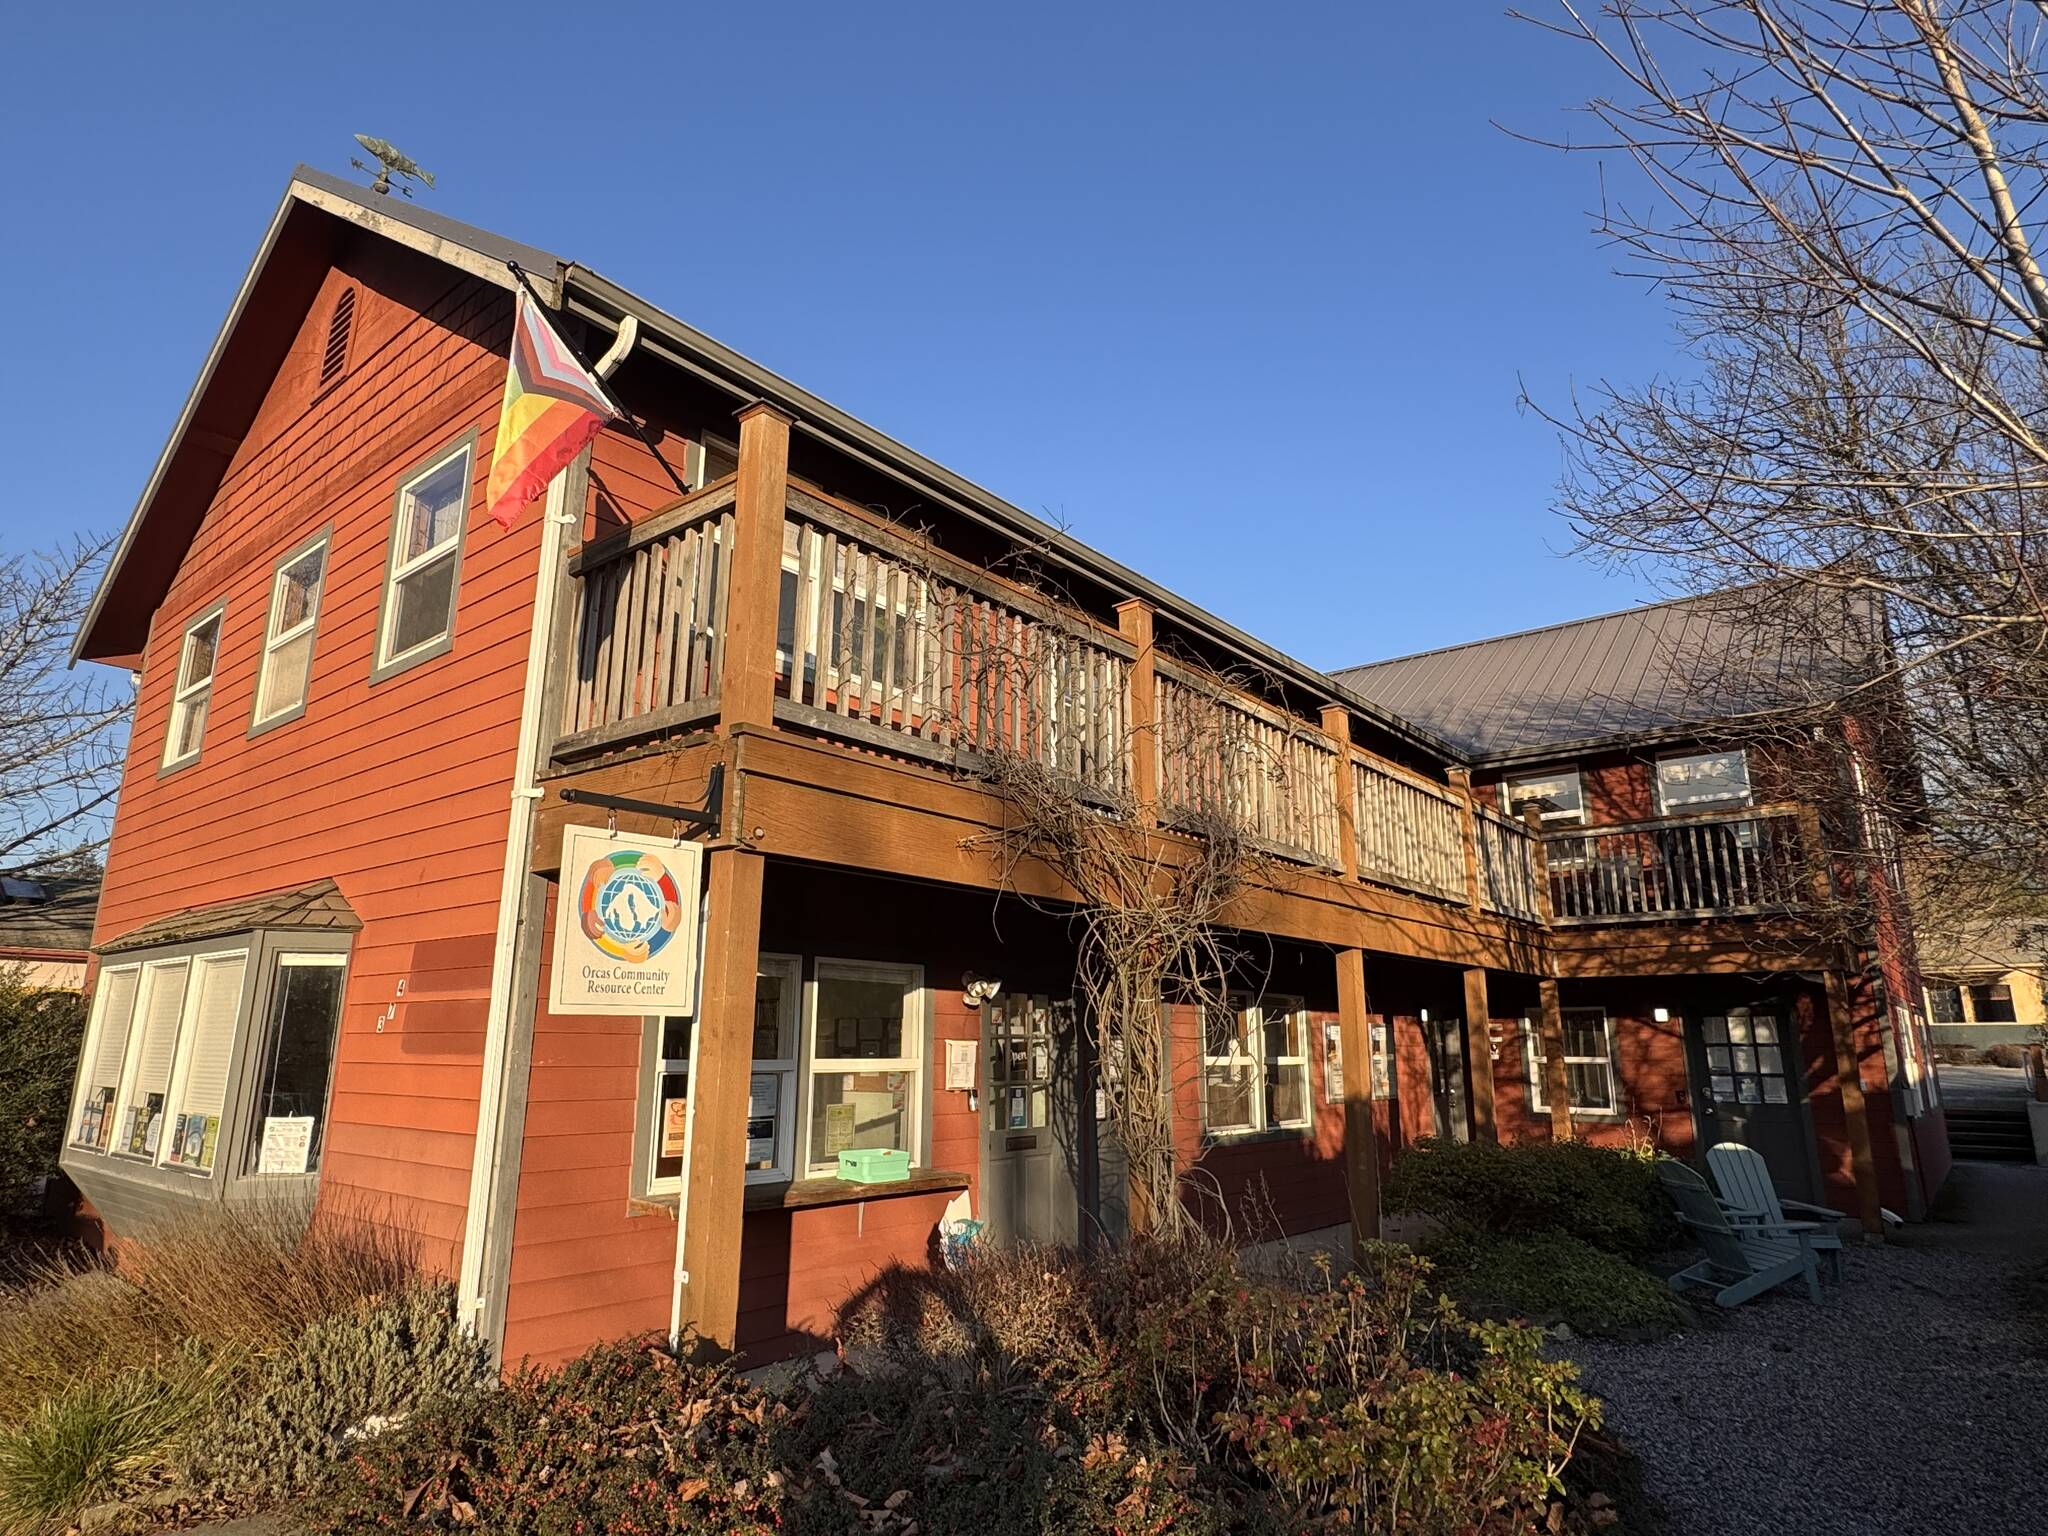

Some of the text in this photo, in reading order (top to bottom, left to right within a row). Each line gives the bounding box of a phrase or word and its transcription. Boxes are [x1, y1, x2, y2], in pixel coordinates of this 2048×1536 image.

[582, 965, 670, 984] Orcas Community
[587, 980, 665, 995] Resource Center
[1011, 1051, 1028, 1066] pen
